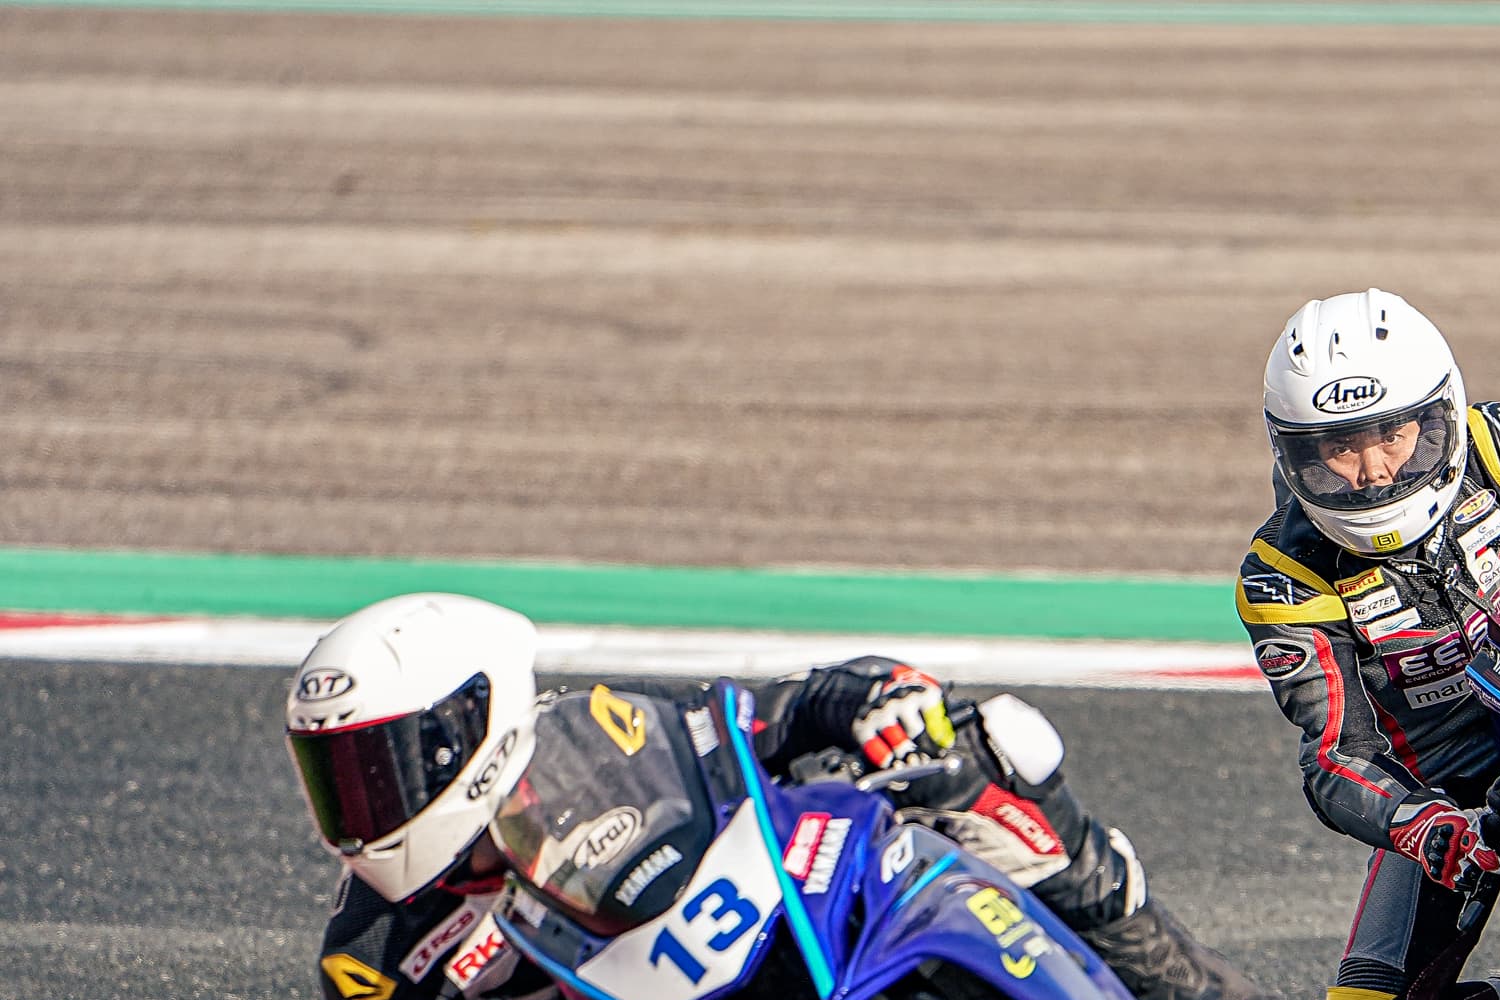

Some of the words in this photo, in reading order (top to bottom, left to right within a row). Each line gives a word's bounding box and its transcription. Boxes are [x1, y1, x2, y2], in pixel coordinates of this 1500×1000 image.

[1317, 377, 1378, 407] Arai
[580, 816, 630, 868] Arai
[451, 928, 506, 982] RK
[650, 877, 760, 985] 13
